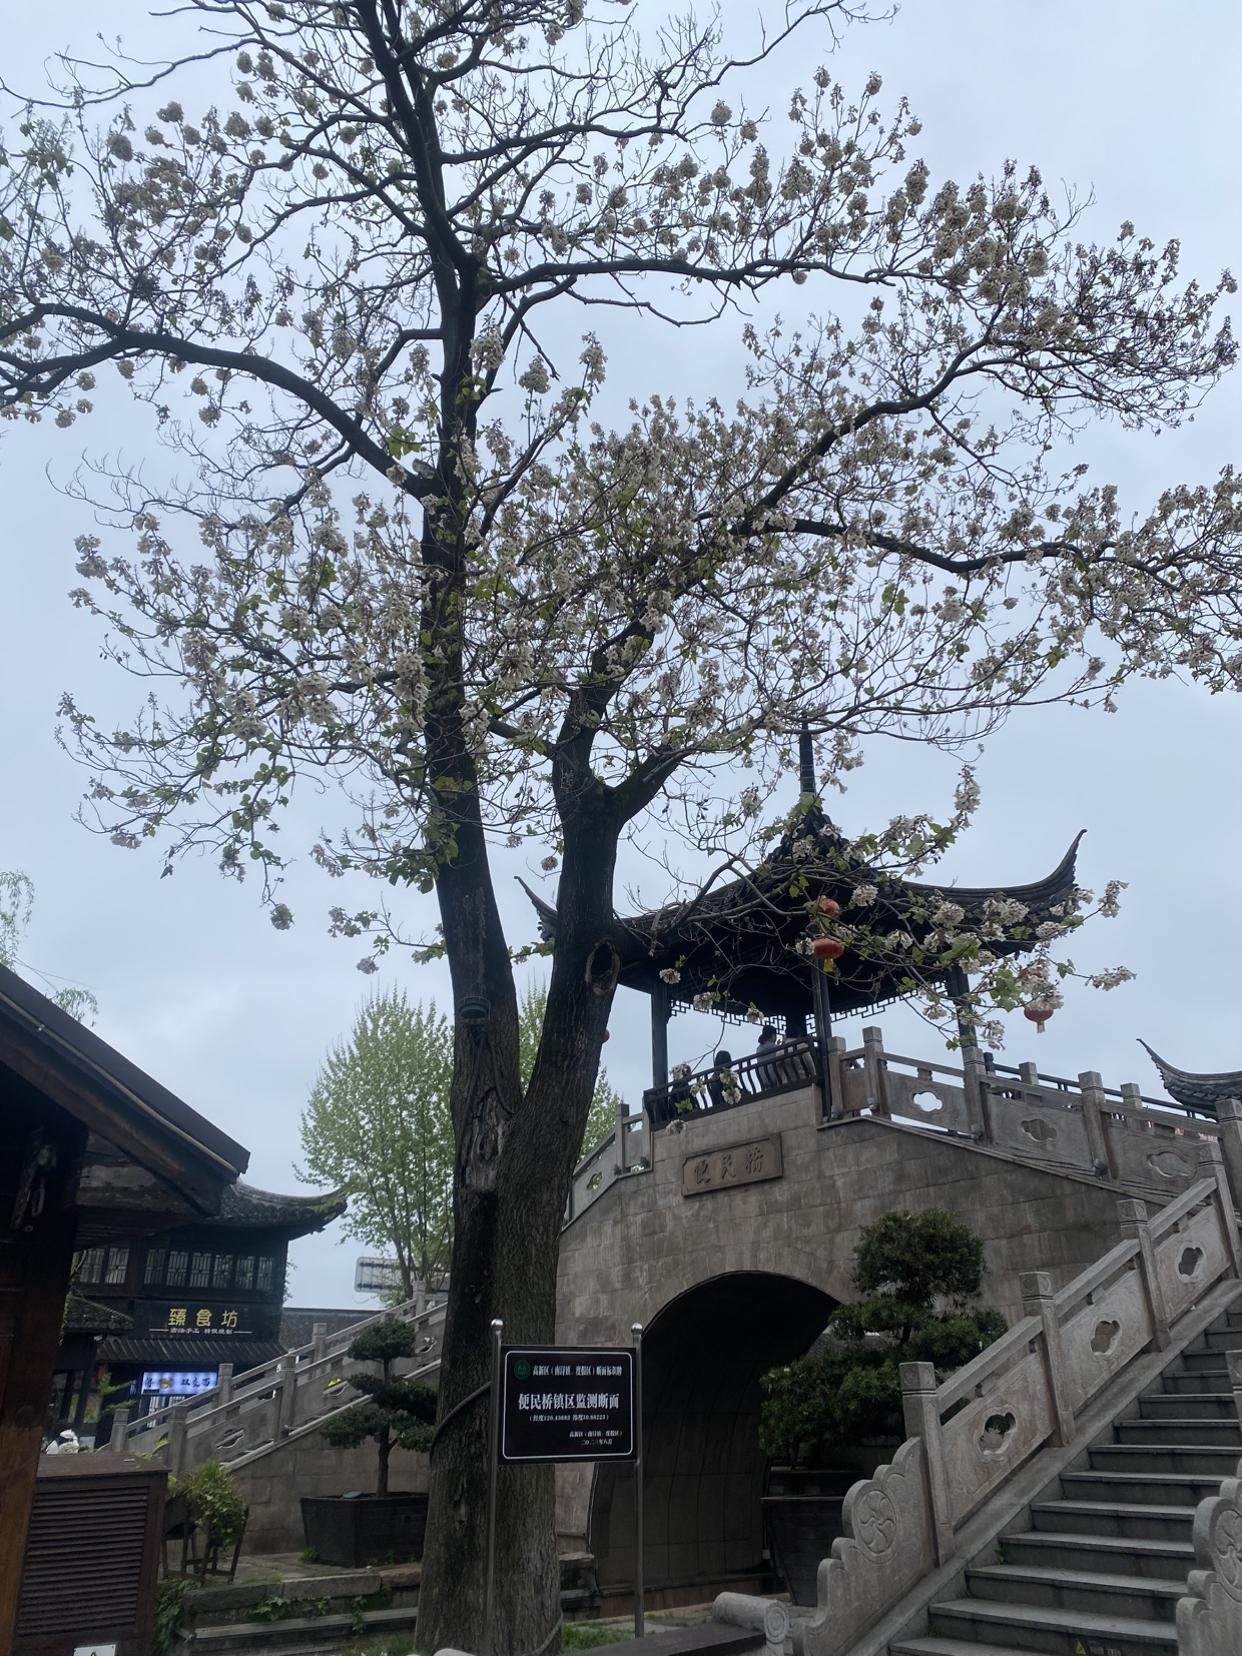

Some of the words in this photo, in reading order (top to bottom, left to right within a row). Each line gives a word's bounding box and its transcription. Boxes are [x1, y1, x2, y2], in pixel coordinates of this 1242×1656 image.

[168, 1308, 238, 1328] 臻食坊
[518, 1393, 620, 1410] 便民桥镇区监测断面
